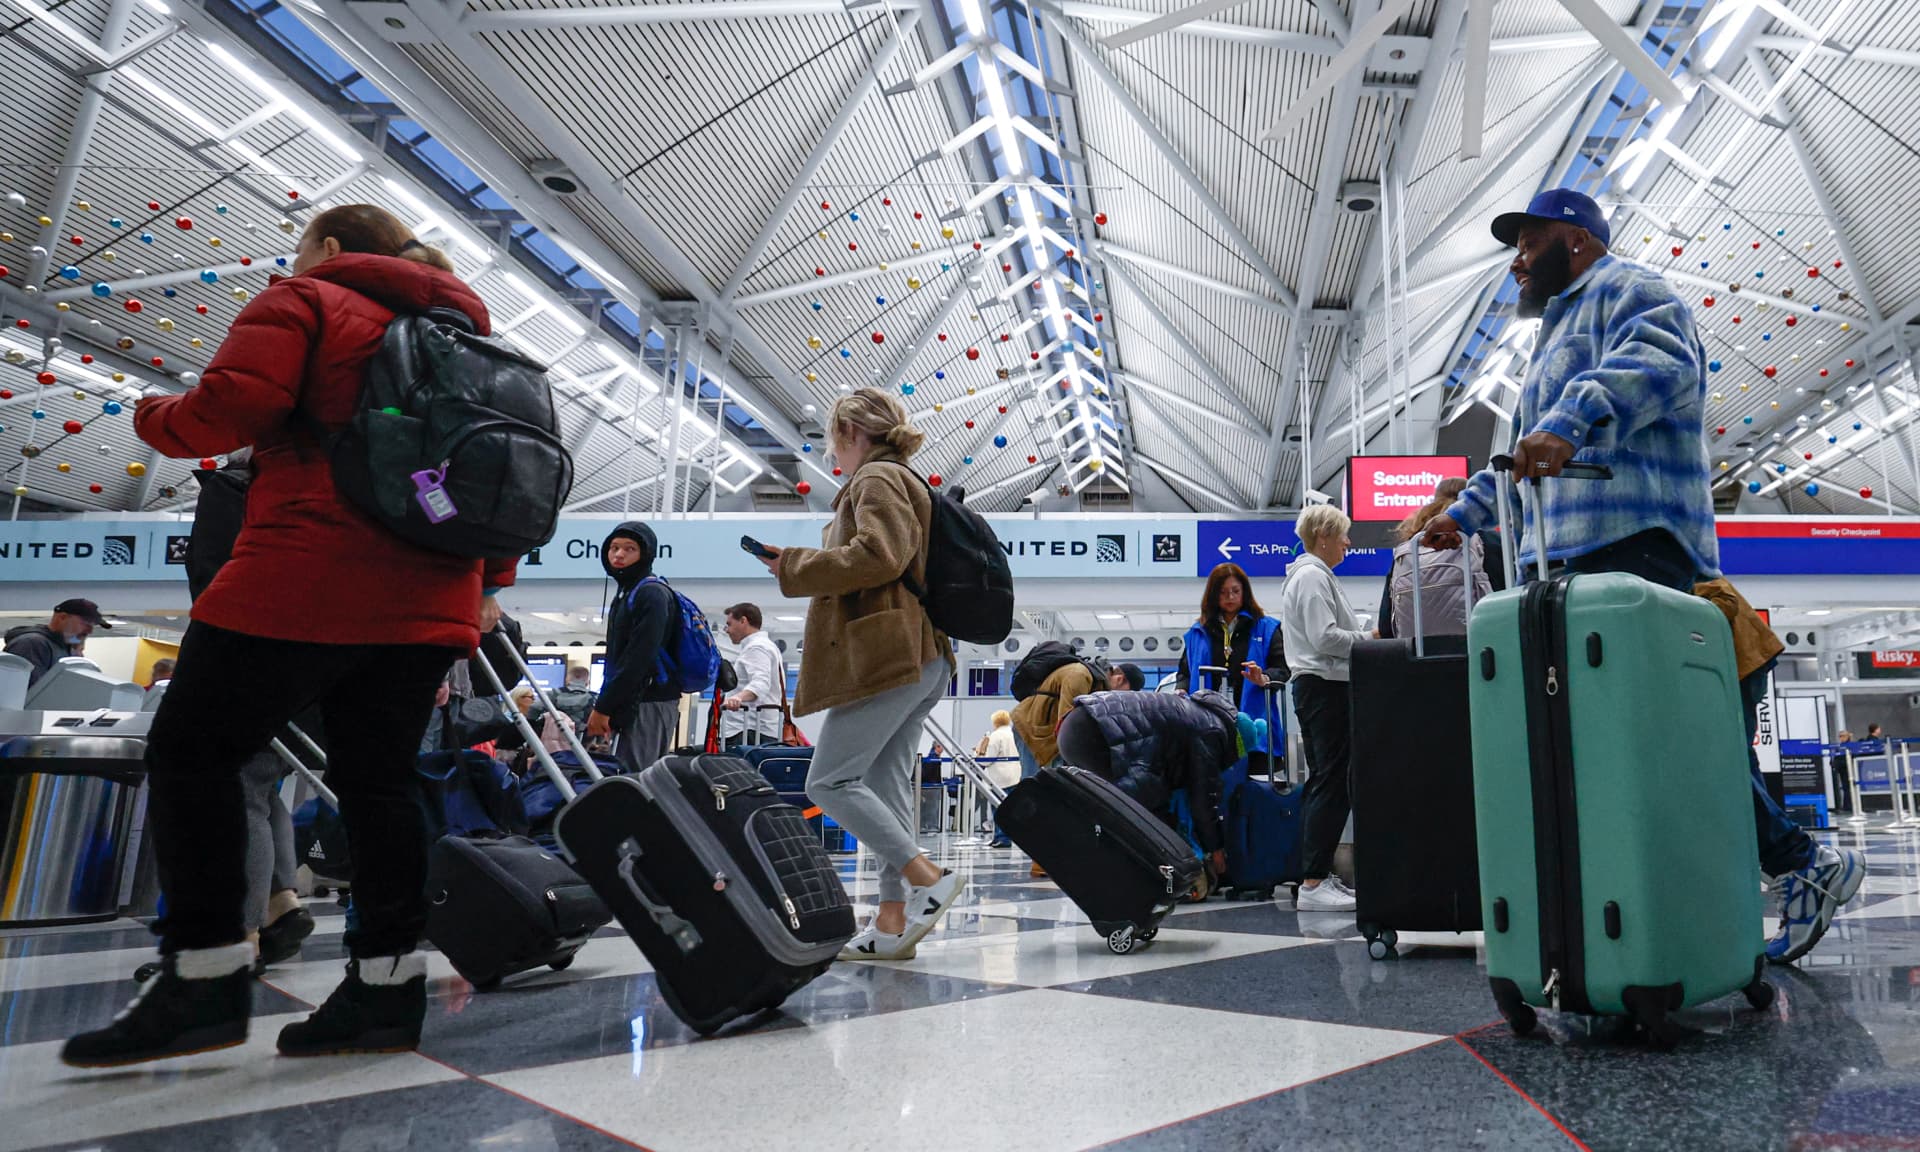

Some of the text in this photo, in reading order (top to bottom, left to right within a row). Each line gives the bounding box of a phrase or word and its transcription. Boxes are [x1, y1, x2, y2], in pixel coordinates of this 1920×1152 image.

[1373, 471, 1443, 489] Security
[1373, 492, 1435, 507] Entranc
[998, 541, 1088, 556] NITED
[1249, 544, 1269, 554] TSA
[1271, 544, 1289, 554] Pre
[1759, 696, 1773, 745] SERVI
